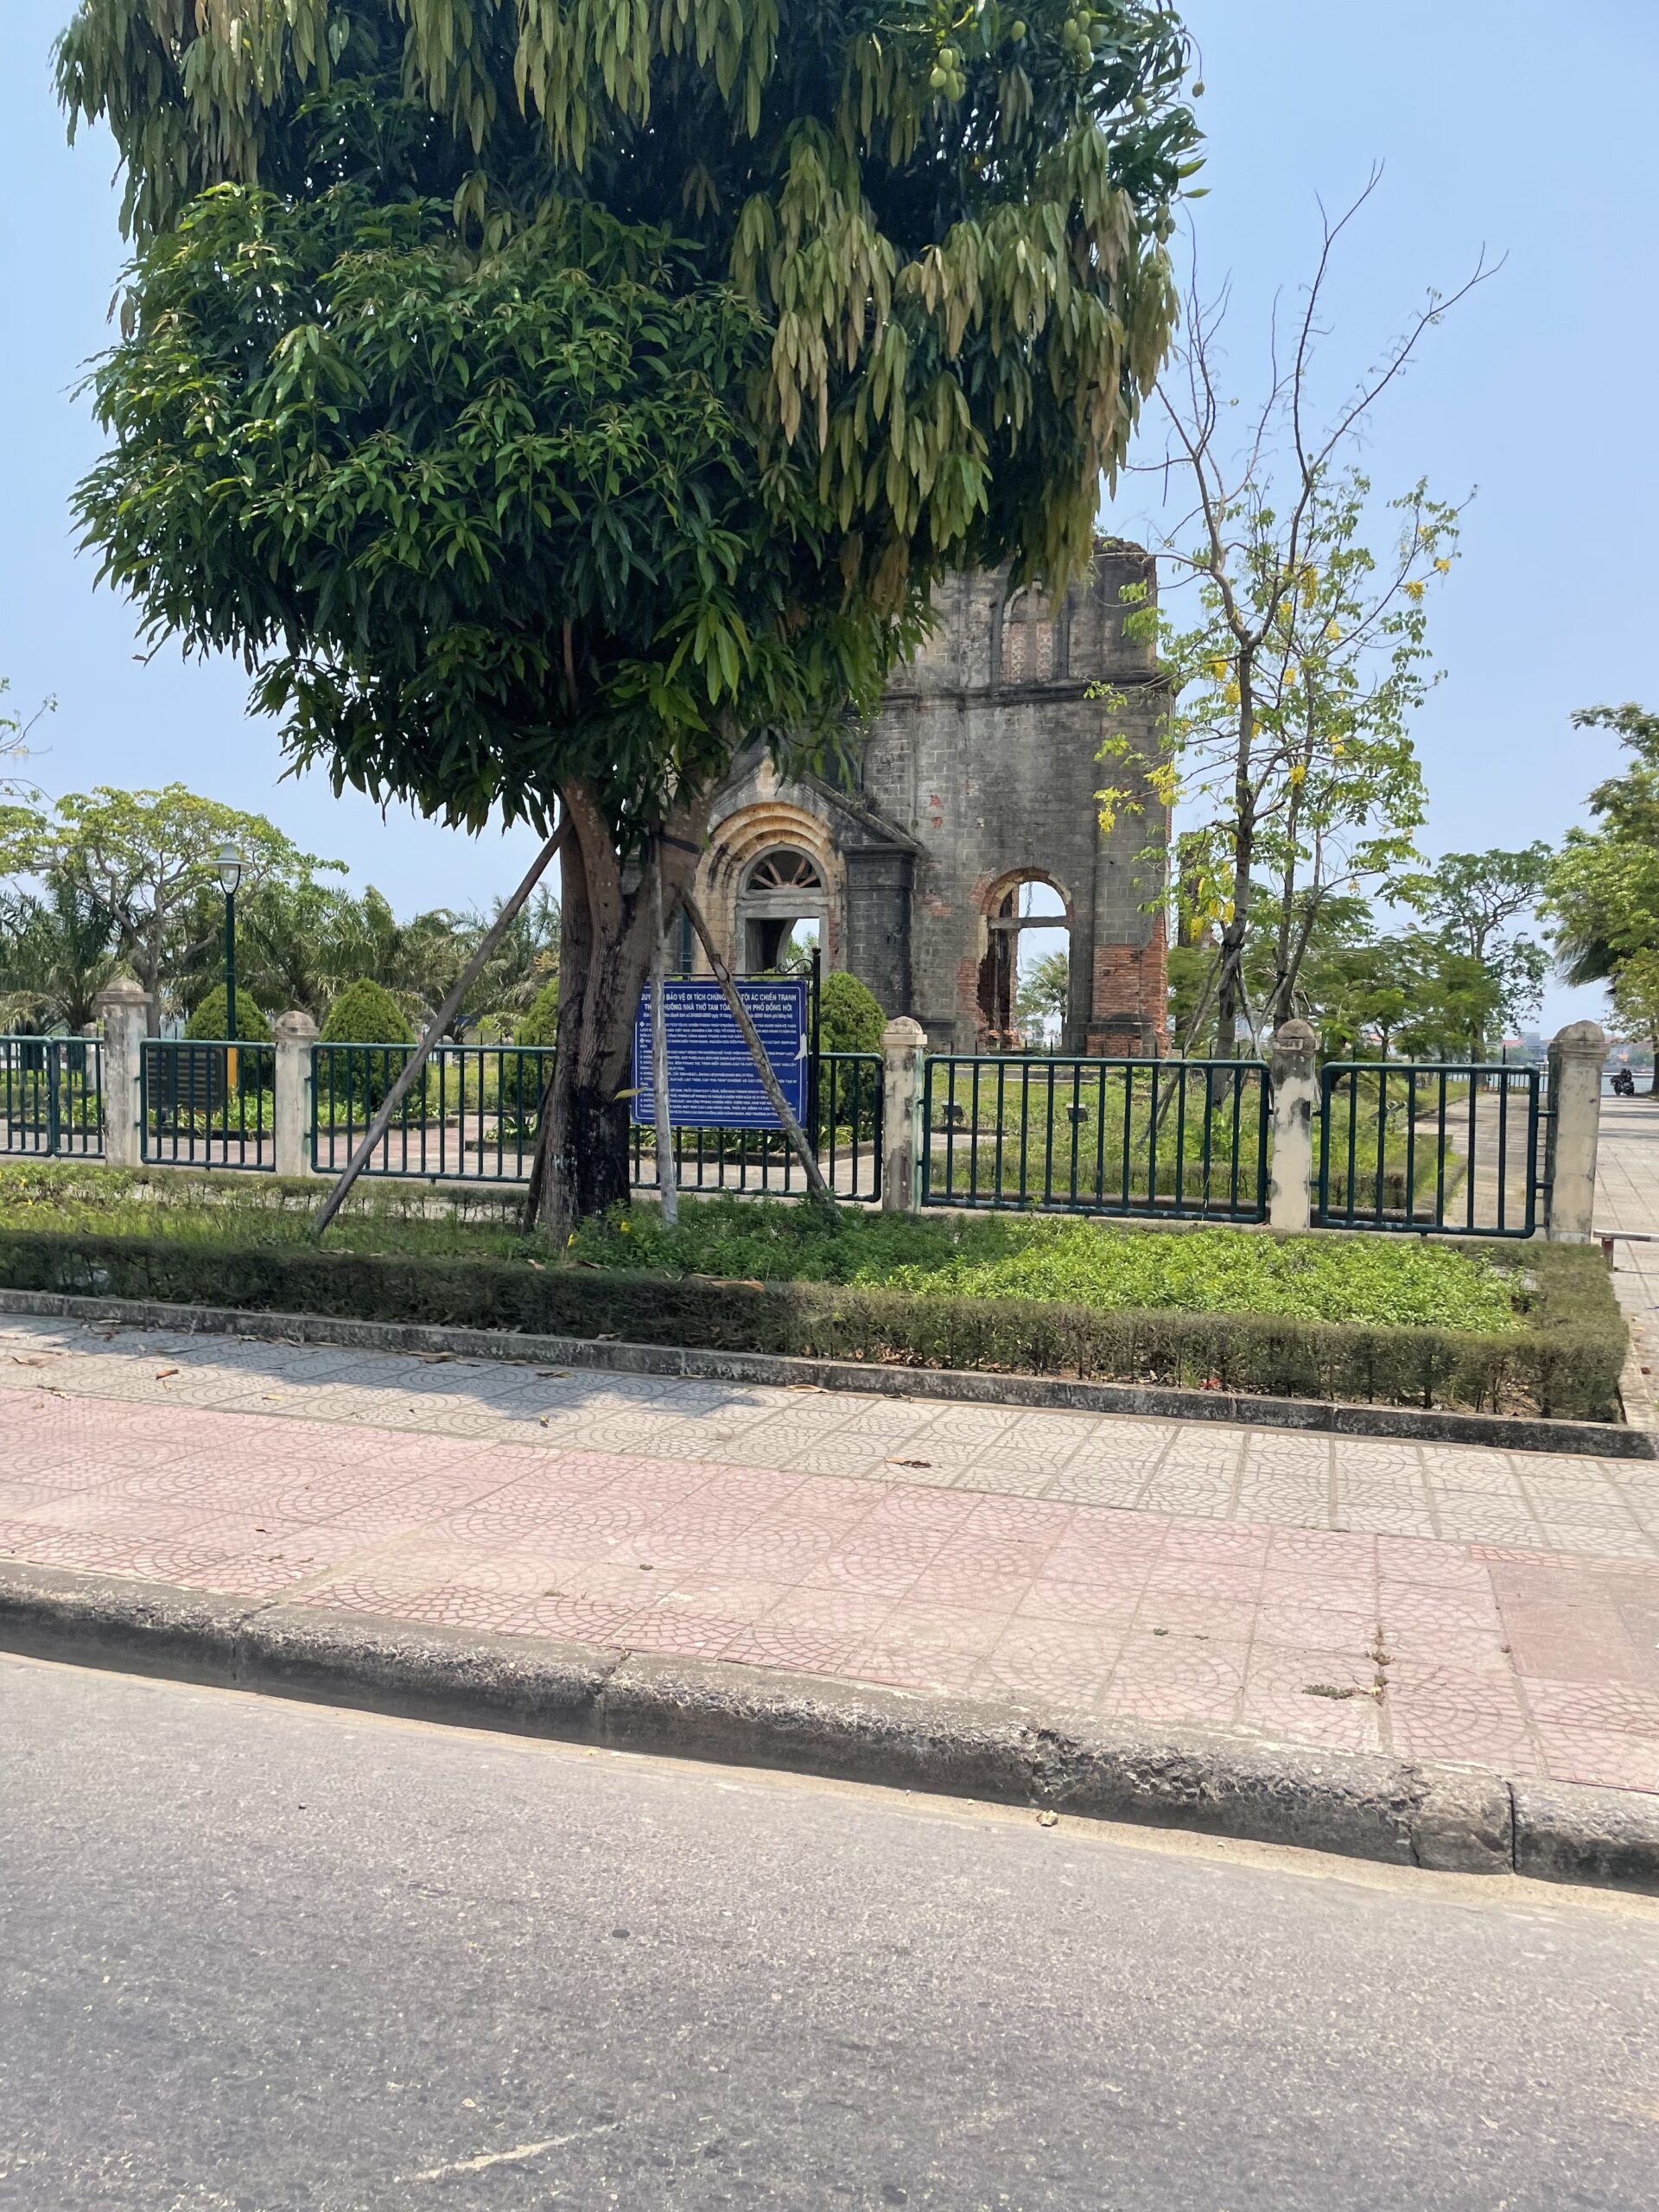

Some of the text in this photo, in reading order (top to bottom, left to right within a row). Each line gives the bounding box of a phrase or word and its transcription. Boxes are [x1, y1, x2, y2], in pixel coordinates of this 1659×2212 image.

[665, 991, 678, 1001] BẢO
[678, 992, 686, 1001] VỆ
[693, 991, 706, 1001] TÍCH
[750, 992, 759, 1001] ÁC
[753, 1001, 765, 1011] PHỐ
